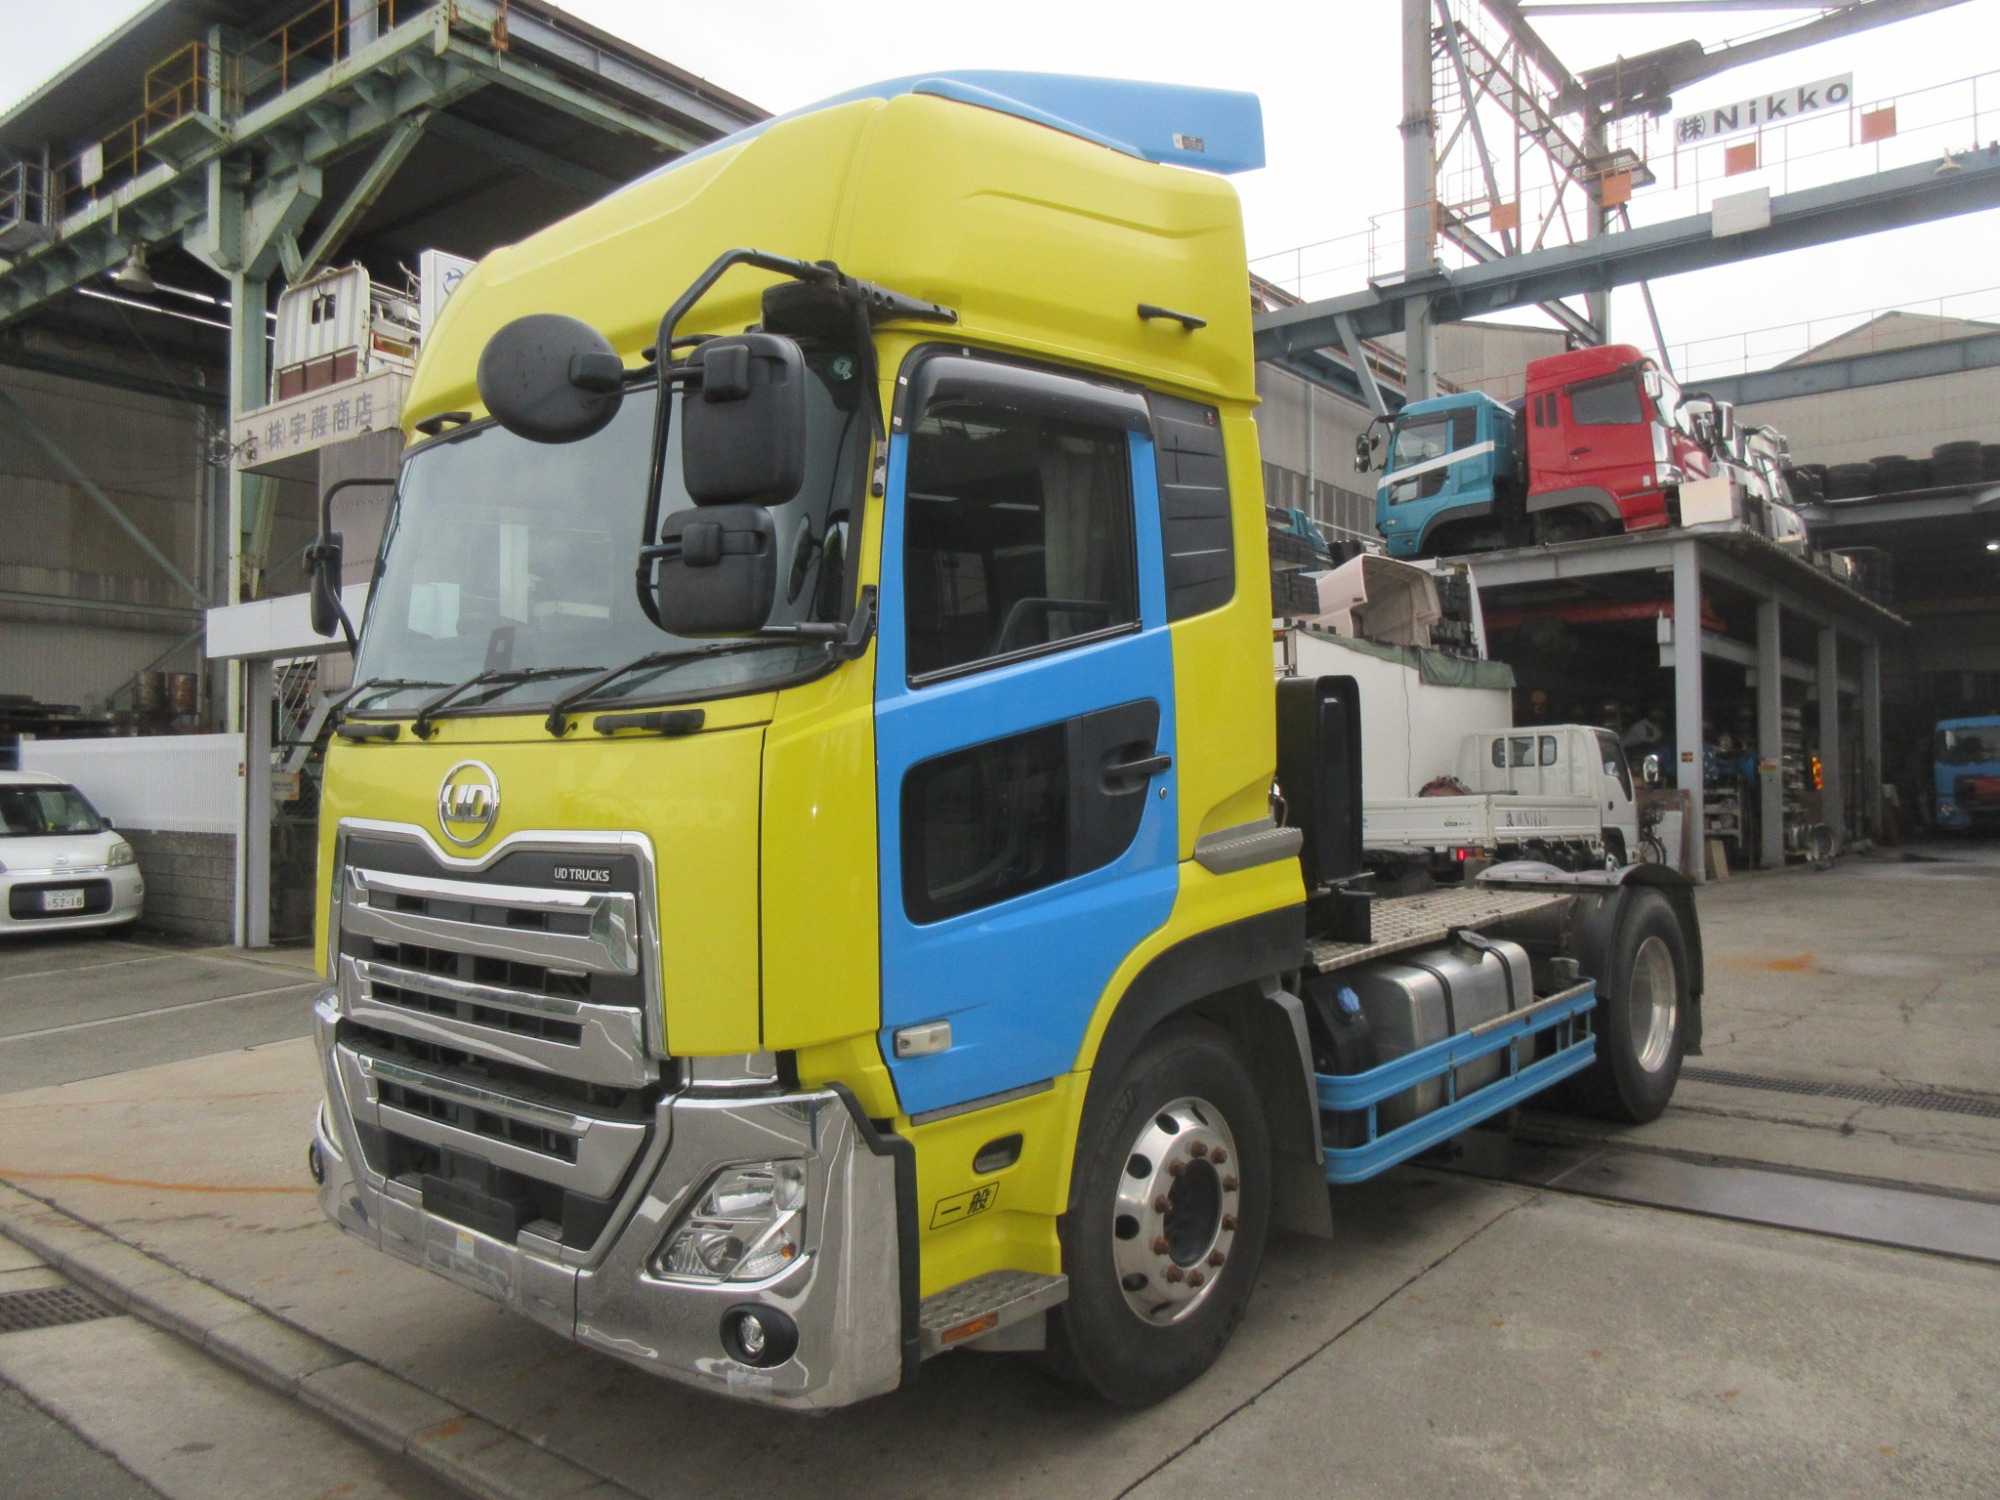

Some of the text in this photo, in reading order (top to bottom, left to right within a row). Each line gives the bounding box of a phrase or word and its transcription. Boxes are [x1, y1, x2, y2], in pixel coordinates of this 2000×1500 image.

[441, 784, 493, 823] UD
[554, 867, 610, 882] UD TRUCKS
[940, 1187, 992, 1215] 一般
